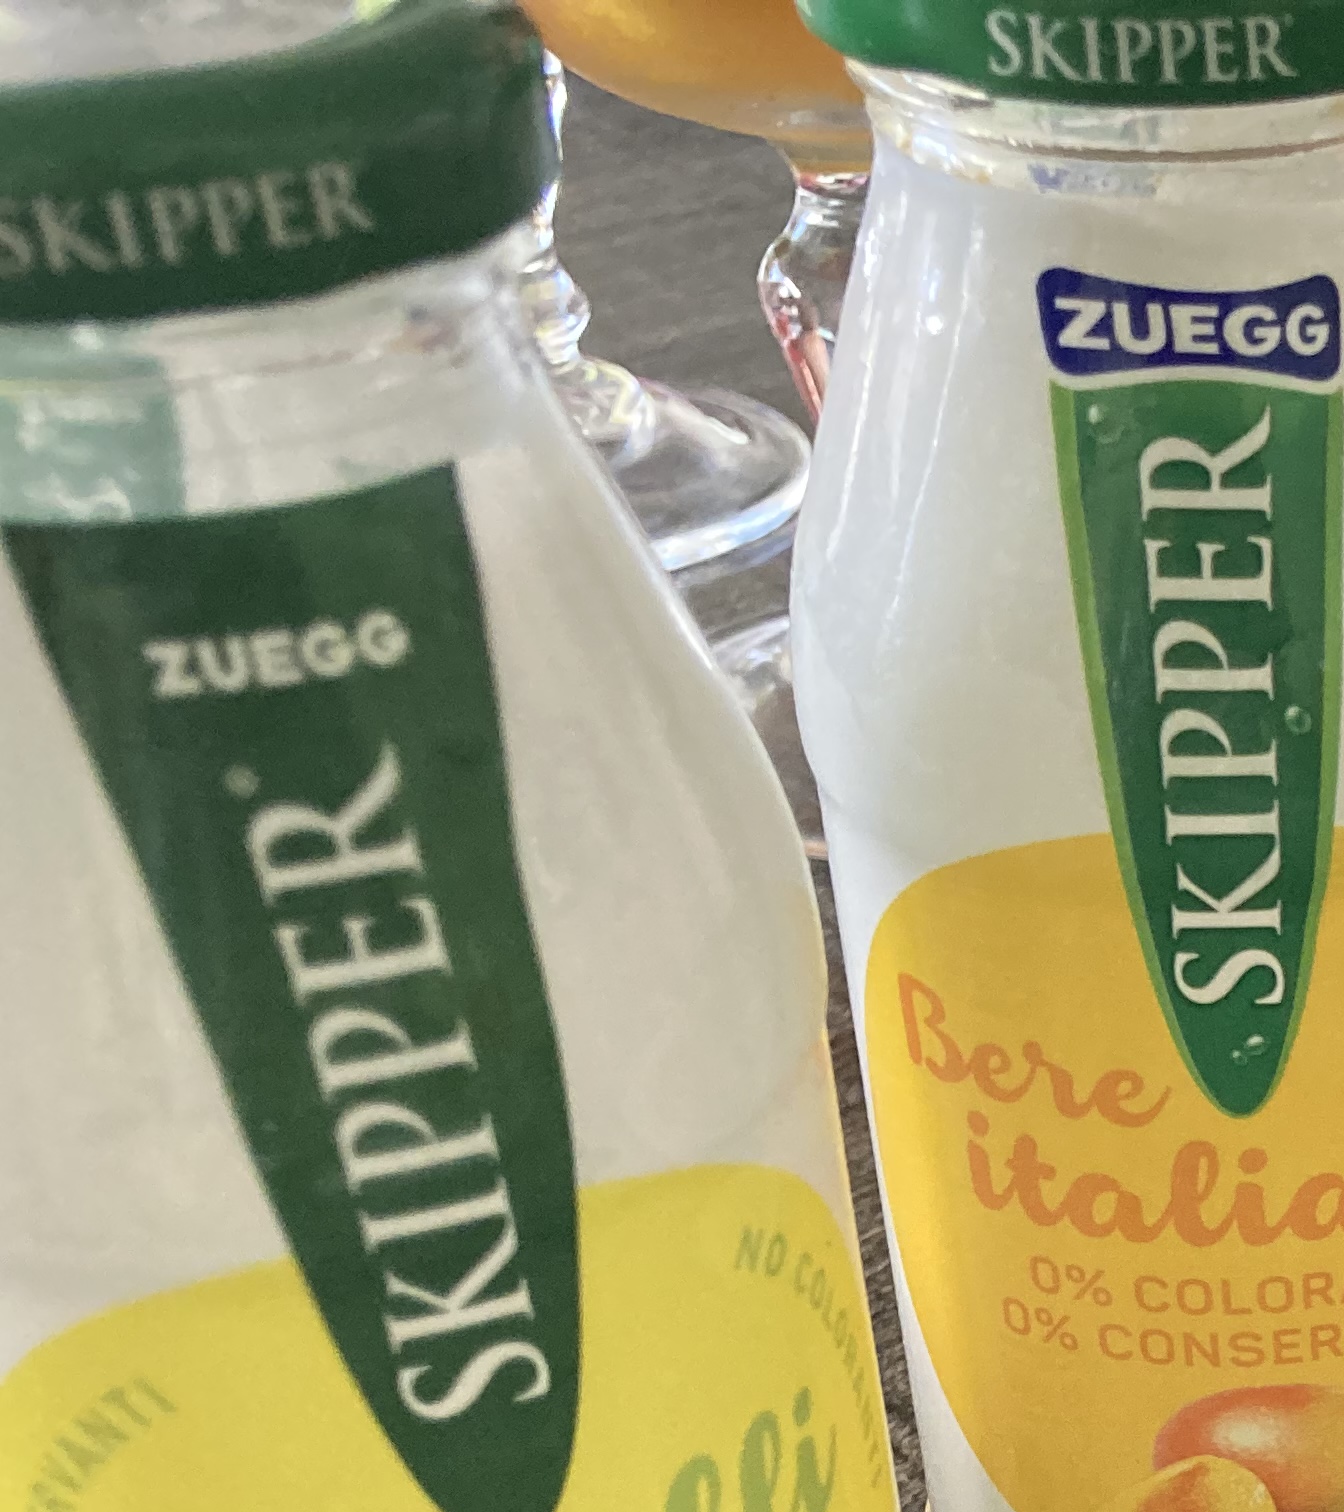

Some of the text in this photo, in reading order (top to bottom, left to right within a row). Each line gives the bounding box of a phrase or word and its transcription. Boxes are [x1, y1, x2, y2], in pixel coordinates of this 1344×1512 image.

[984, 11, 1298, 83] SKIPPER
[0, 160, 375, 278] SKIPPER
[1054, 298, 1331, 356] ZUEGG
[143, 610, 412, 701] ZUEGG
[1138, 404, 1286, 1006] SKIPPER
[246, 738, 551, 1422] SKIPPER
[897, 972, 1172, 1128] Bere
[733, 1224, 788, 1278] NO
[1030, 1255, 1113, 1306] 0%
[1002, 1298, 1078, 1351] 0%
